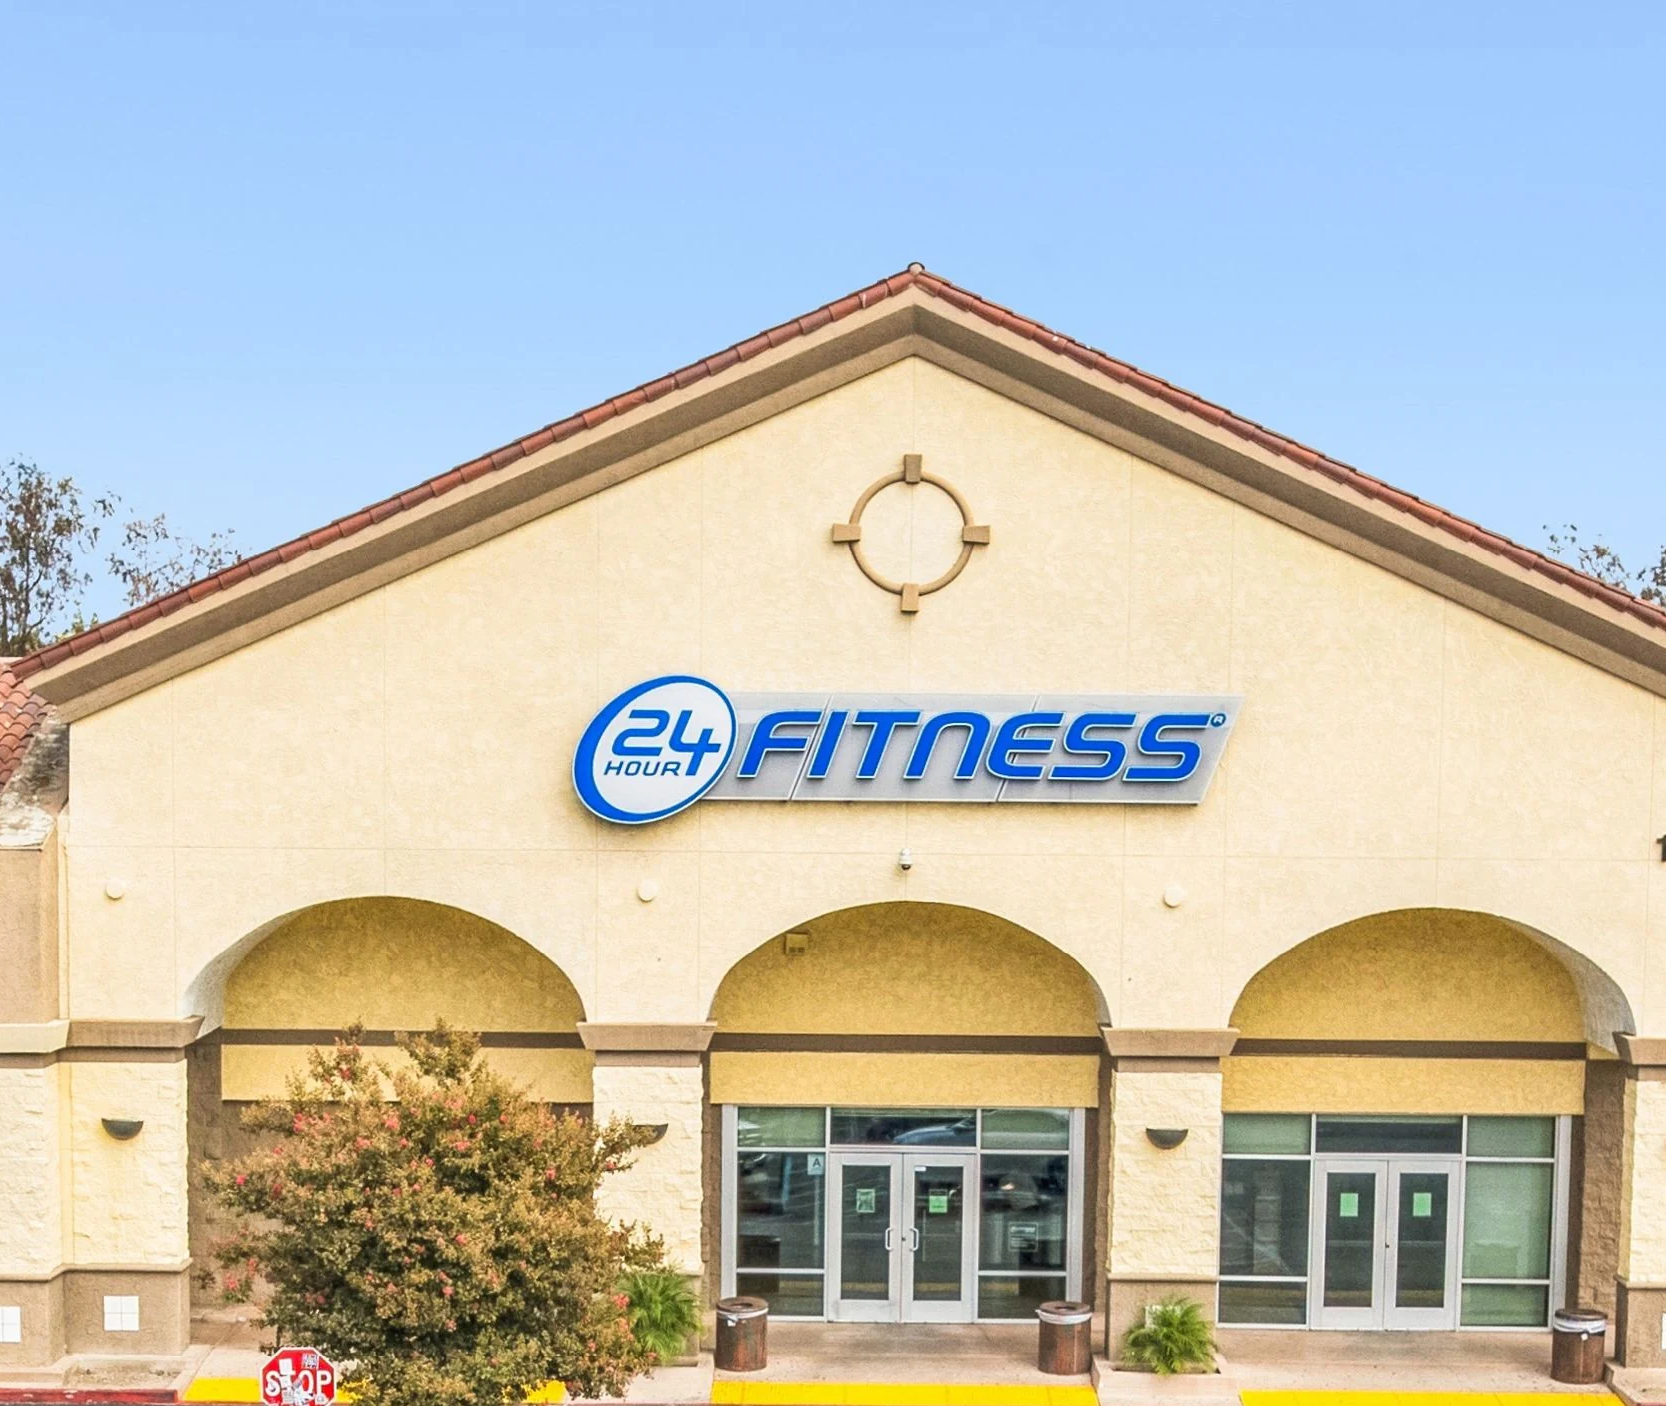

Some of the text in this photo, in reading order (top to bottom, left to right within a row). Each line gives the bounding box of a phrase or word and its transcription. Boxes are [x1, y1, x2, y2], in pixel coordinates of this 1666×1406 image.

[603, 761, 681, 776] HOUR
[611, 709, 722, 776] 24
[737, 710, 1211, 781] FITNESS
